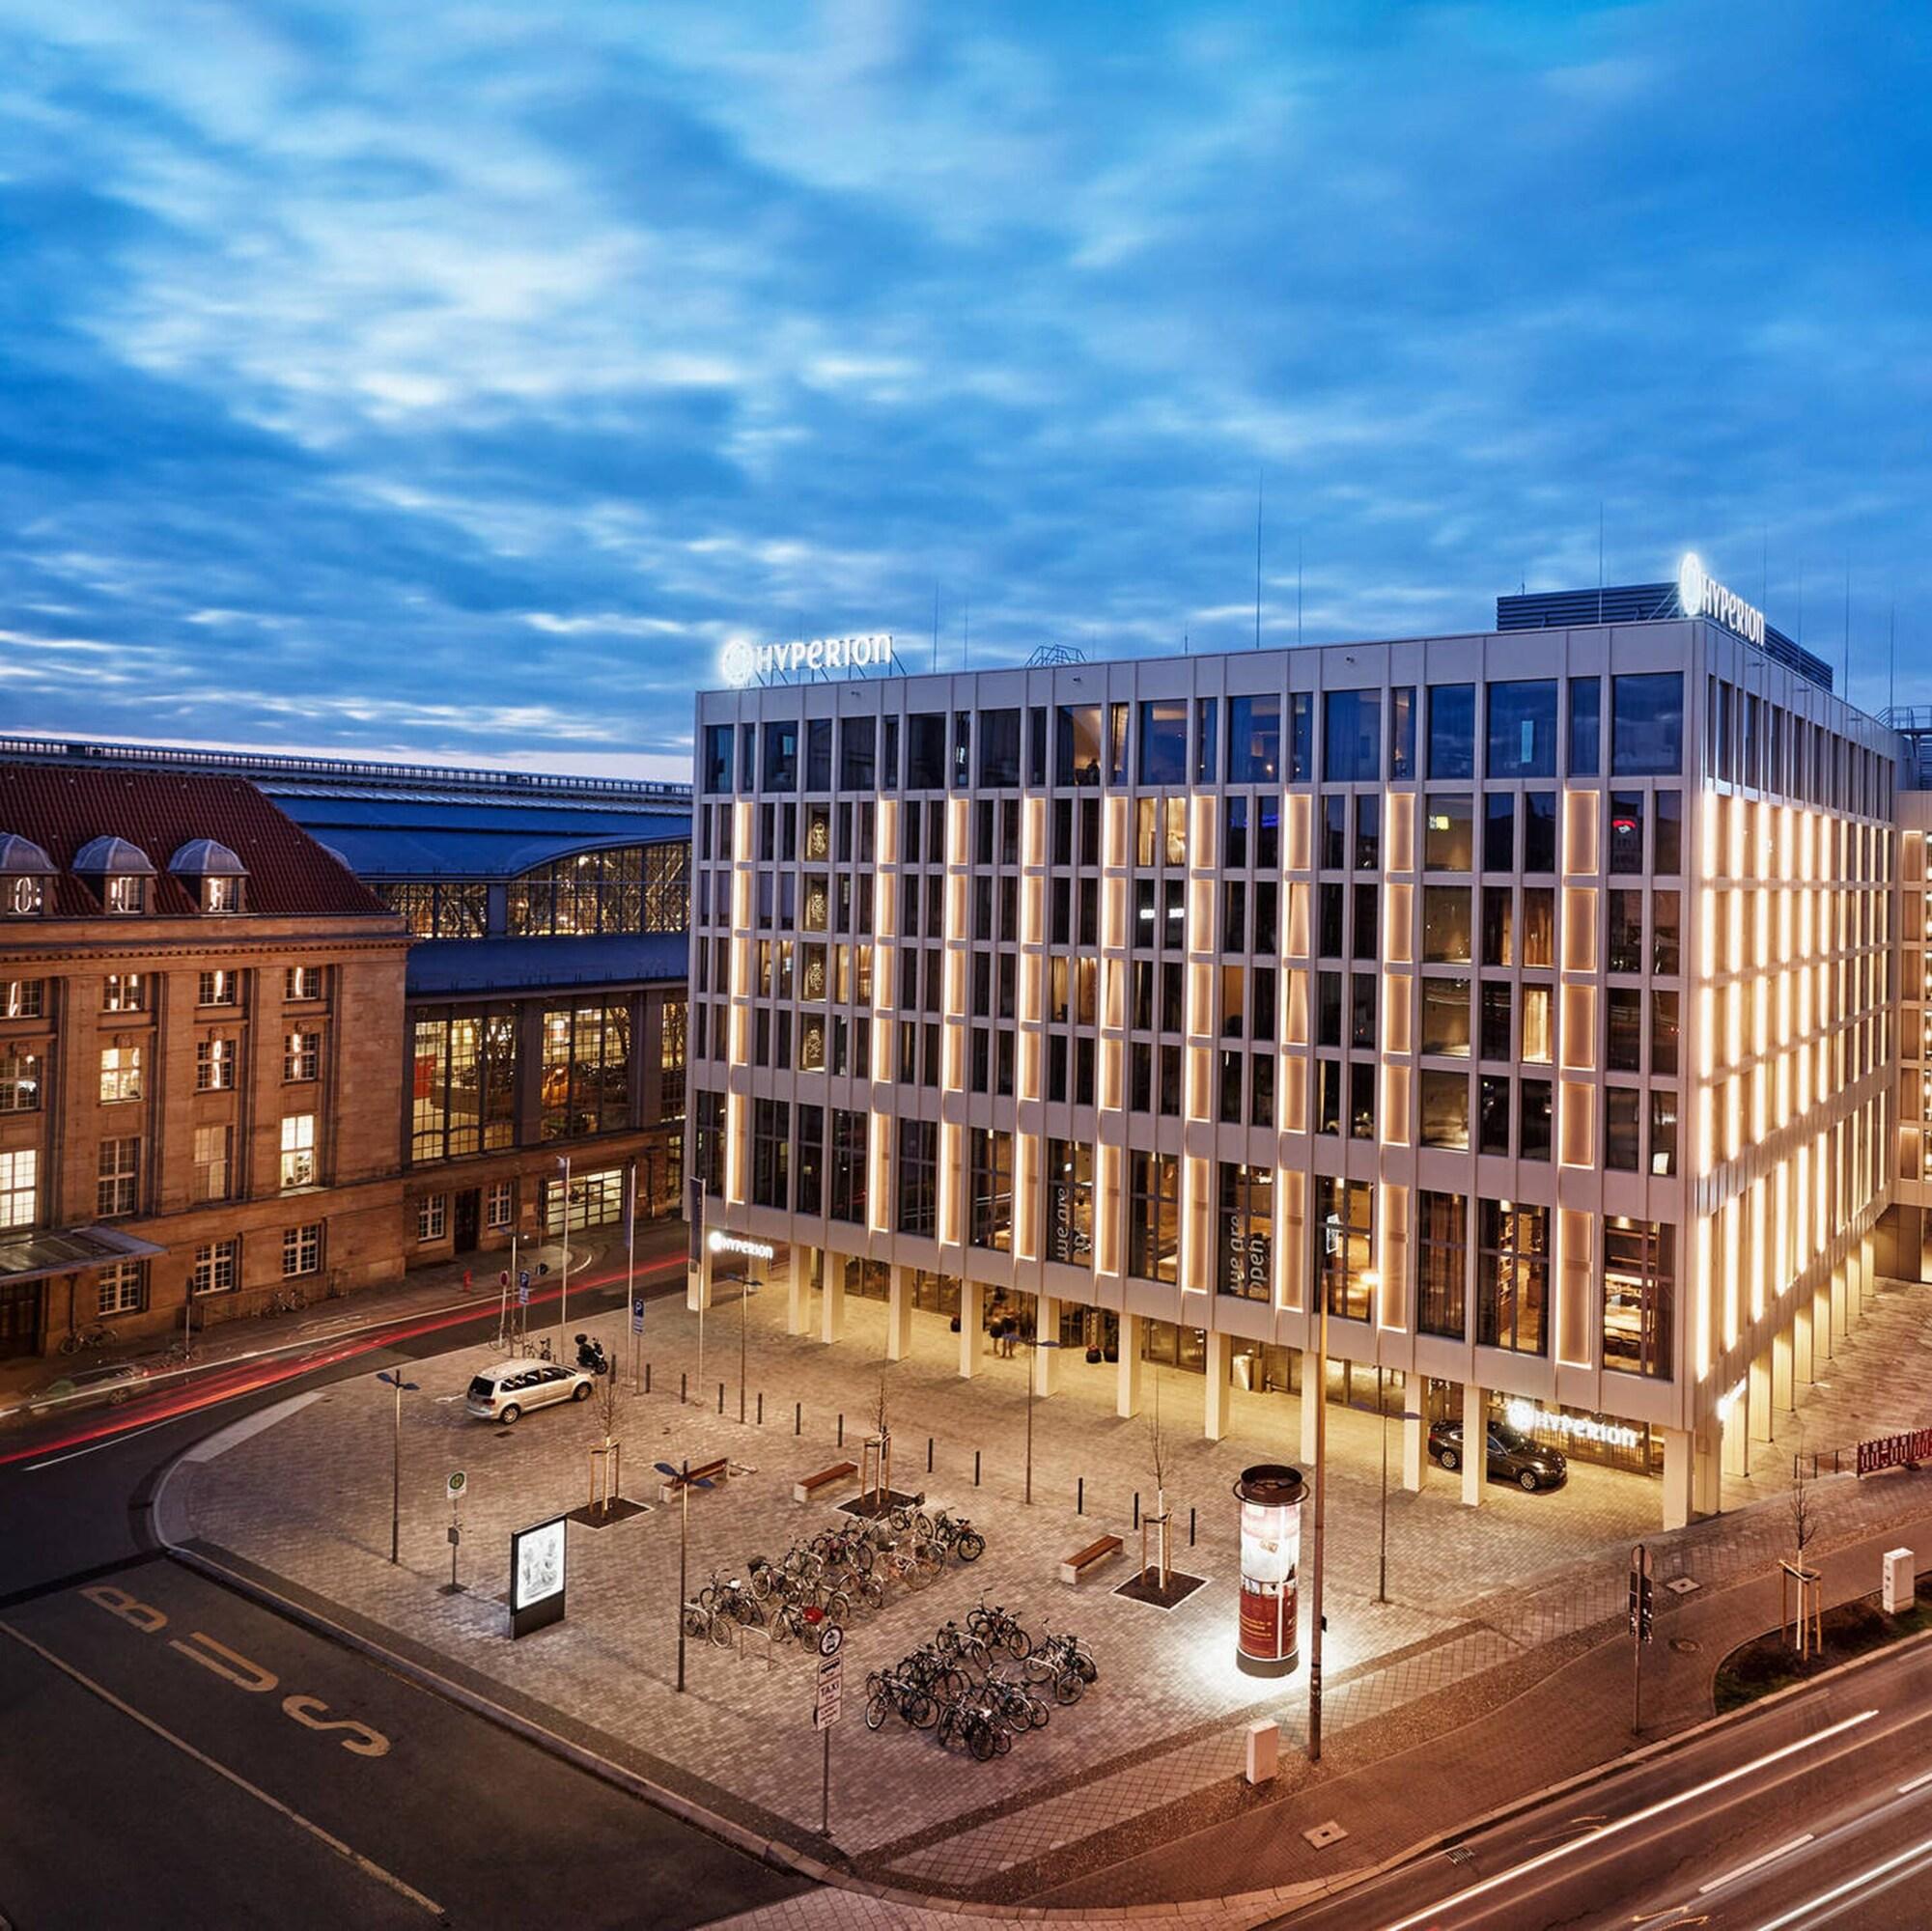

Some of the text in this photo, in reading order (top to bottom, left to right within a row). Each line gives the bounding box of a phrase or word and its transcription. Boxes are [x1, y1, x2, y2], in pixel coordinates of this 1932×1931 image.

[1249, 1239, 1267, 1294] open
[635, 1301, 642, 1313] P
[78, 1585, 391, 1756] BUS
[821, 1681, 840, 1696] TAXI
